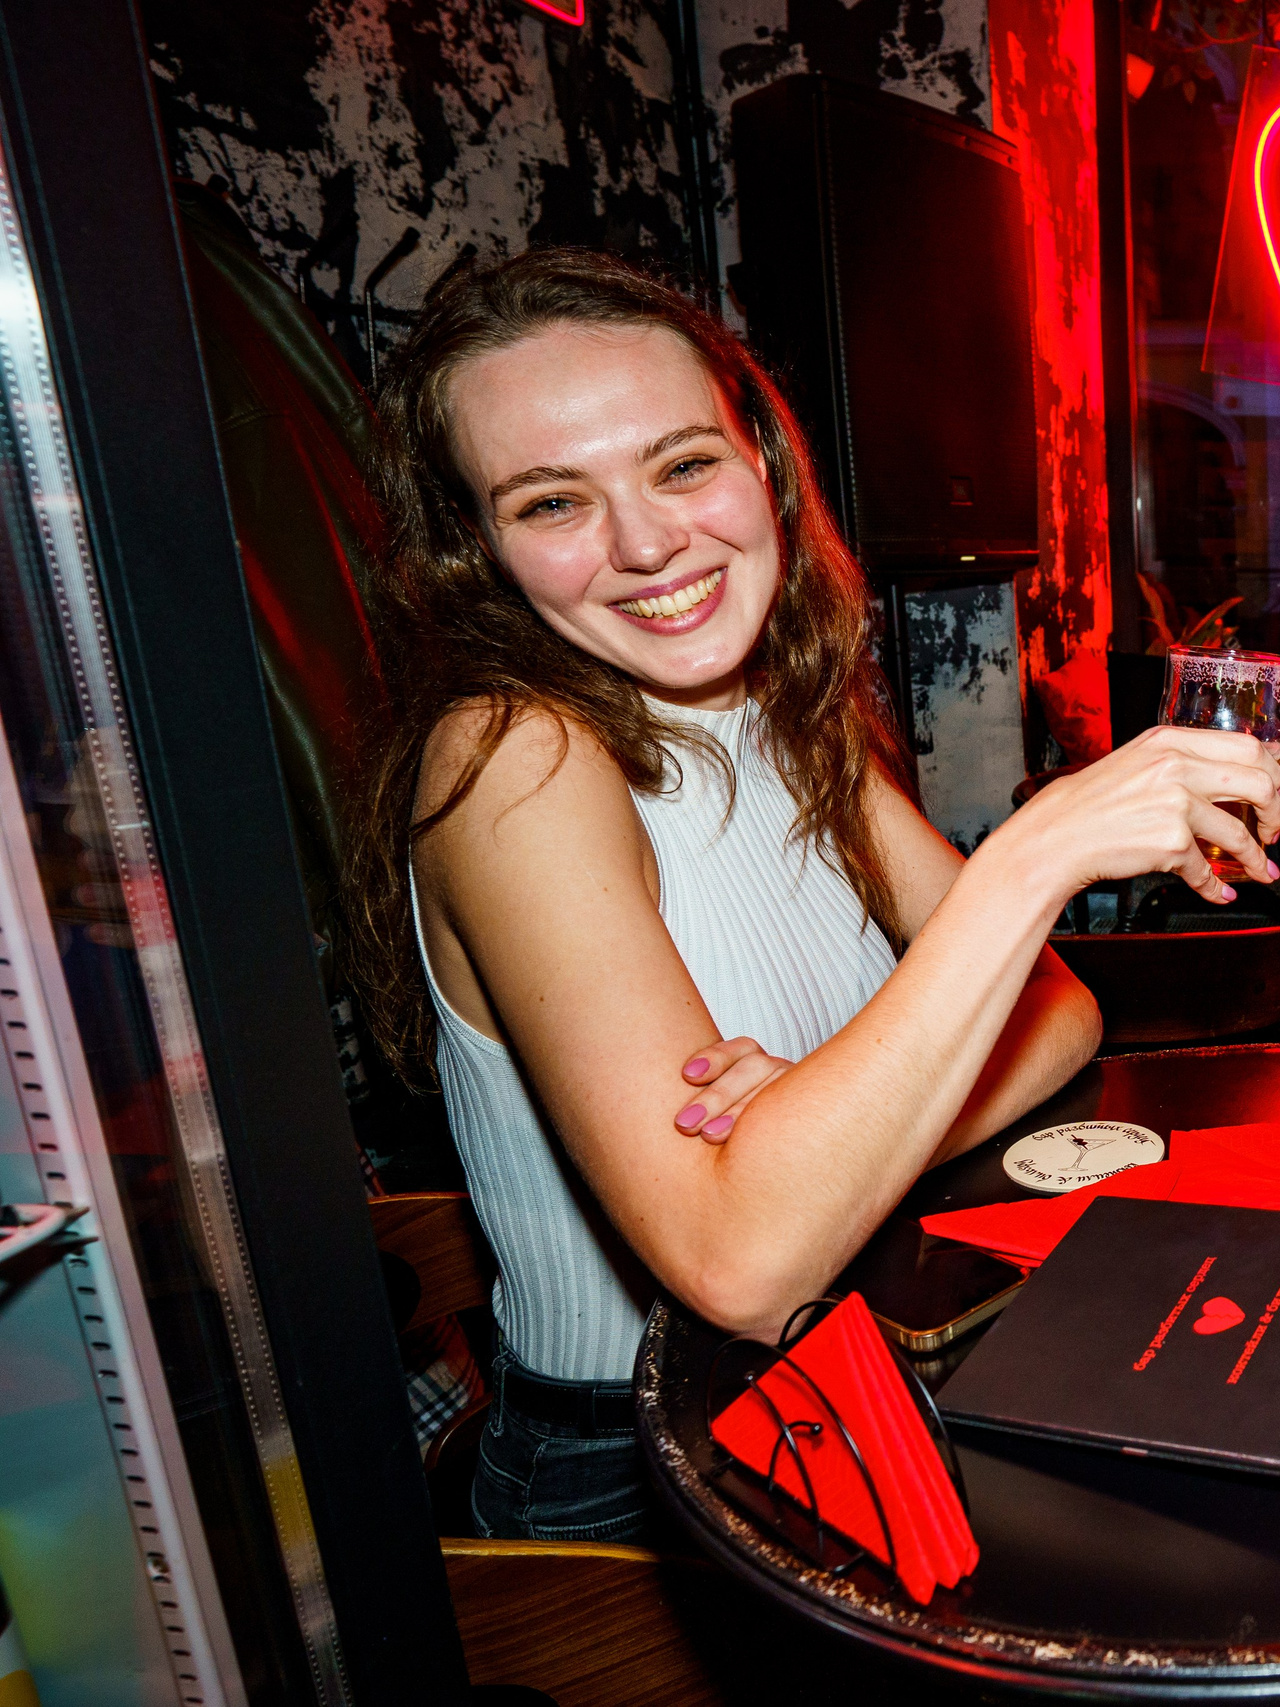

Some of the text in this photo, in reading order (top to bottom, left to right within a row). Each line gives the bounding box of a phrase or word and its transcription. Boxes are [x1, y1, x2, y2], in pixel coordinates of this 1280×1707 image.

[1133, 1256, 1217, 1371] бар разбитых сердец
[1226, 1324, 1268, 1384] коктейли
[1259, 1312, 1274, 1324] &
